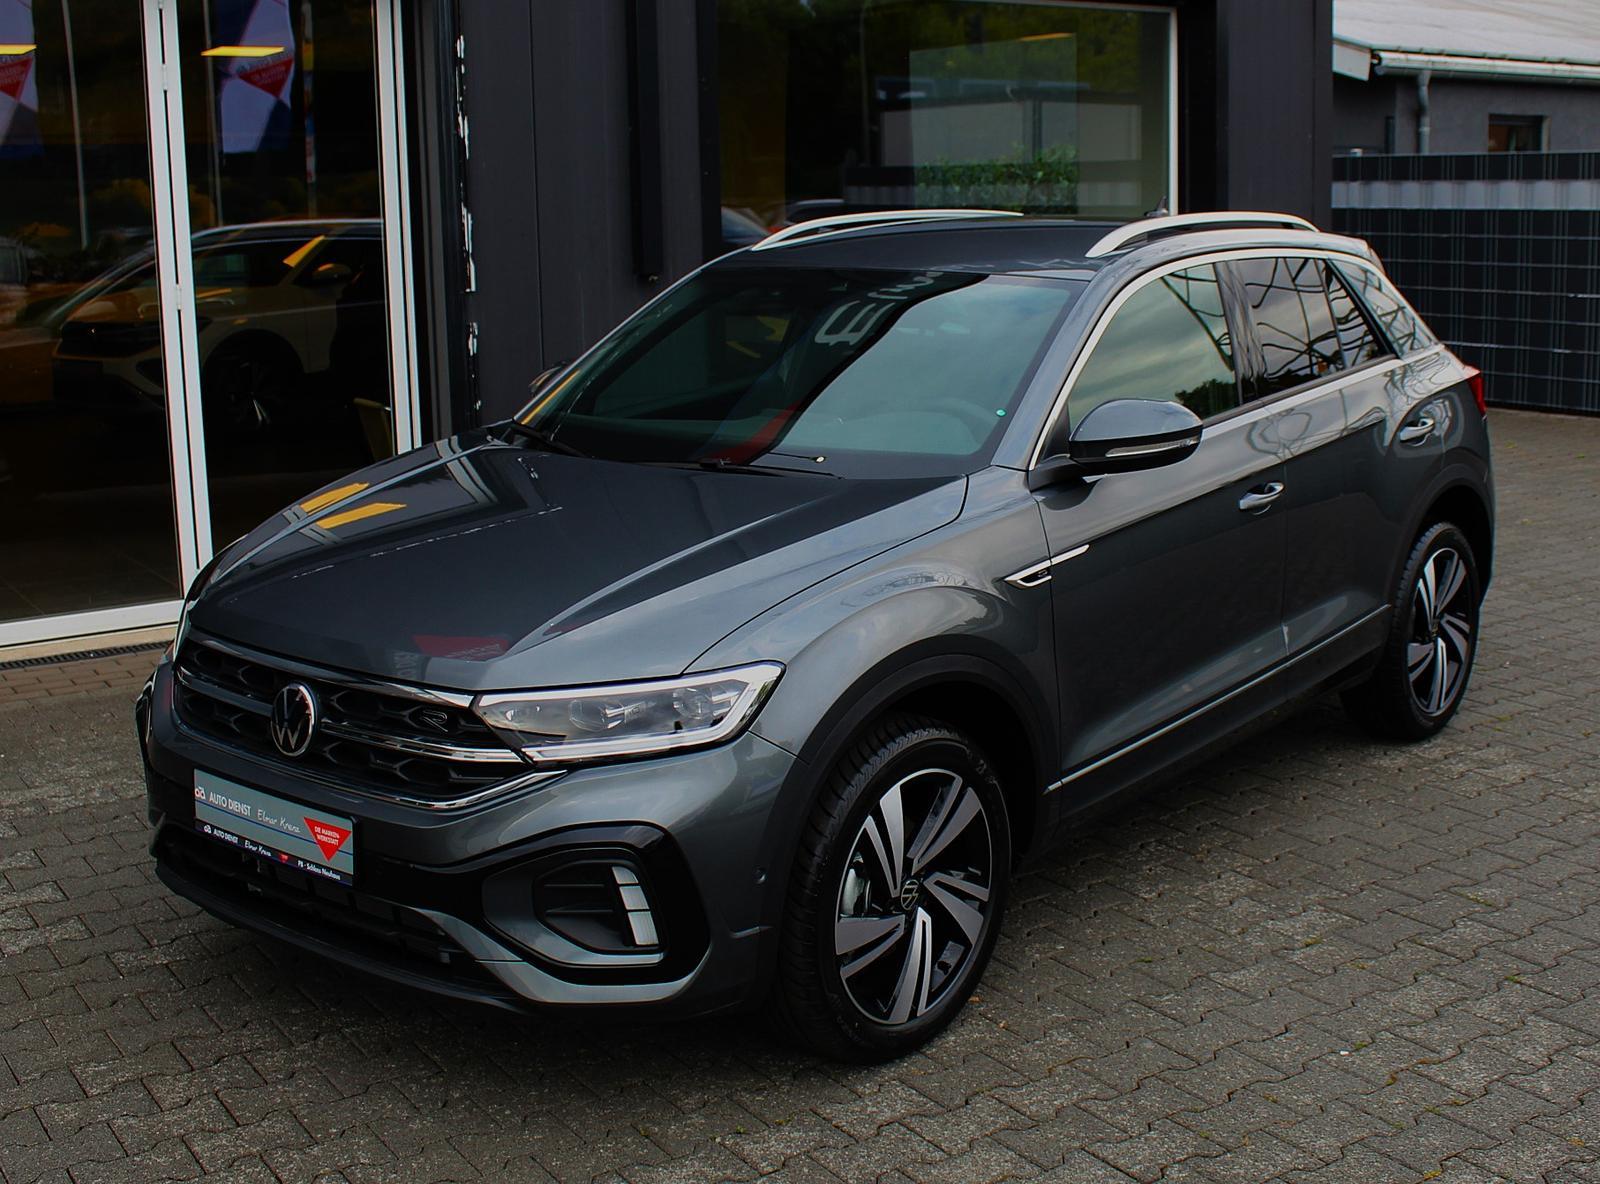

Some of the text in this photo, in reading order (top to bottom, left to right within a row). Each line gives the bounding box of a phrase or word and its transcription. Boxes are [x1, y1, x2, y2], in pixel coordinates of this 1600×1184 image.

[208, 791, 228, 808] AUTO
[228, 798, 251, 817] DIENST
[213, 828, 225, 839] AUTO
